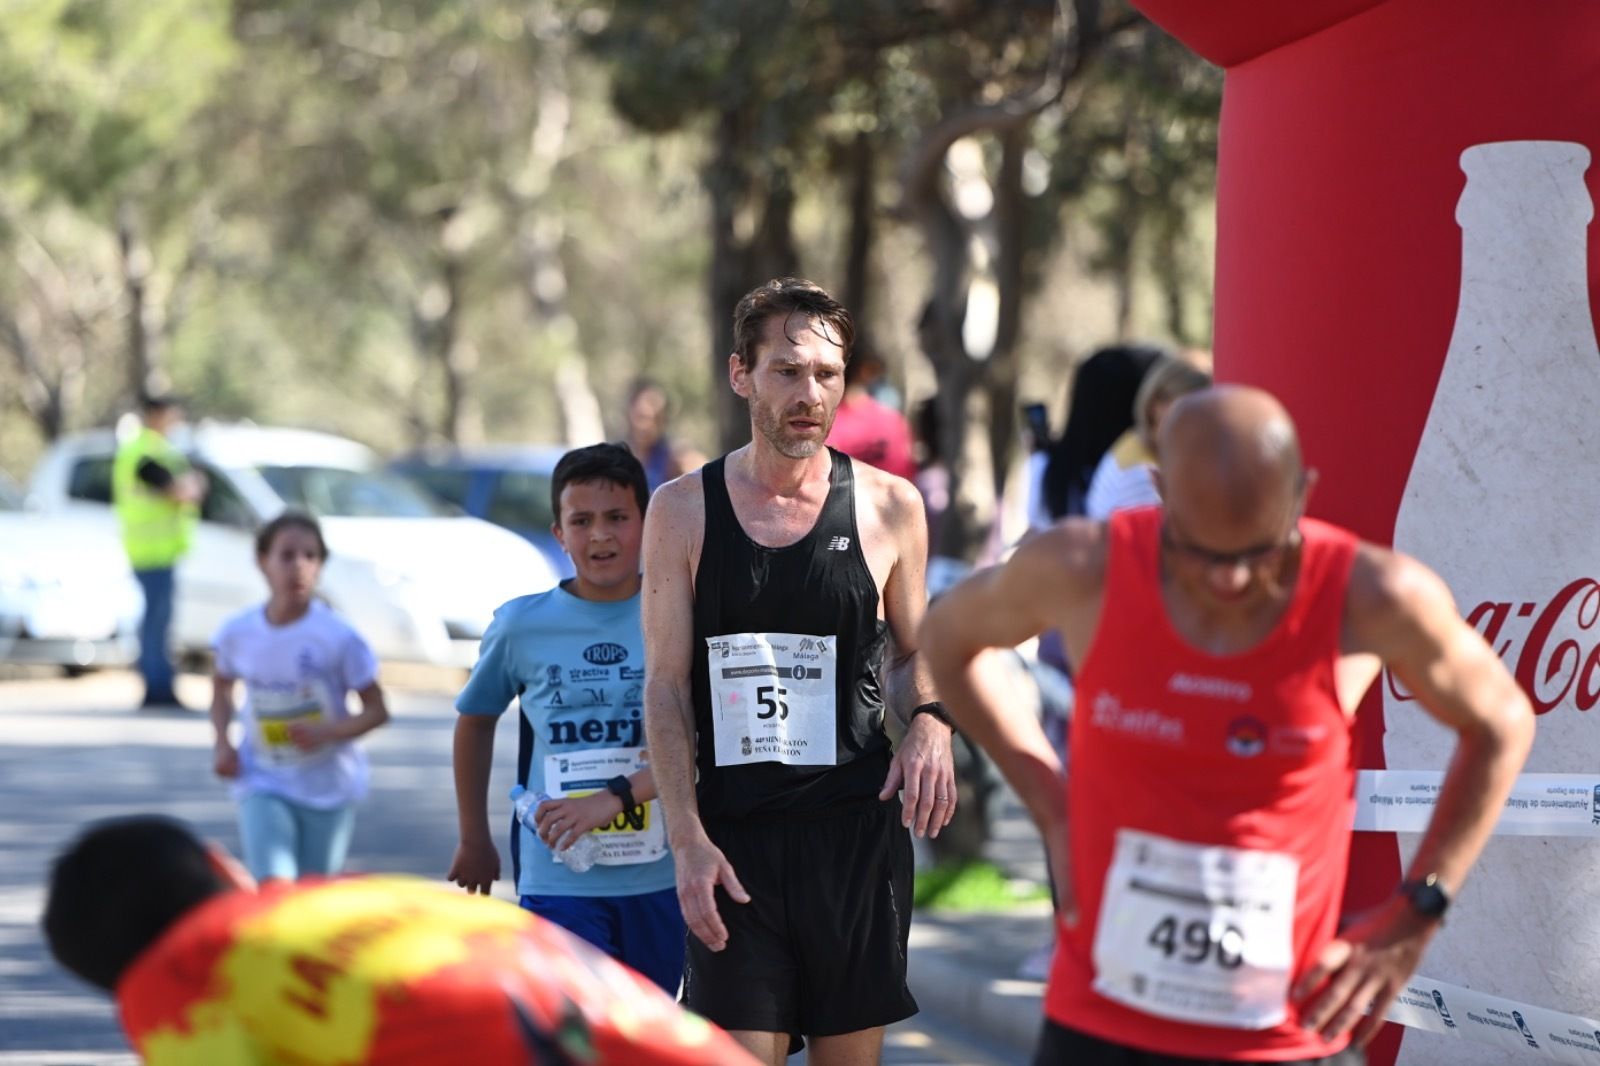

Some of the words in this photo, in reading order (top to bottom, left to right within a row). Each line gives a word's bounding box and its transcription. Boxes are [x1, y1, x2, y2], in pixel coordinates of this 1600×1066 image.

[585, 644, 627, 662] TROPS
[793, 652, 819, 661] Málaga
[548, 709, 643, 748] nerj
[1370, 795, 1394, 806] Málaga
[1395, 796, 1404, 806] de
[1529, 799, 1539, 809] de
[1539, 799, 1589, 811] Ayuntamiento
